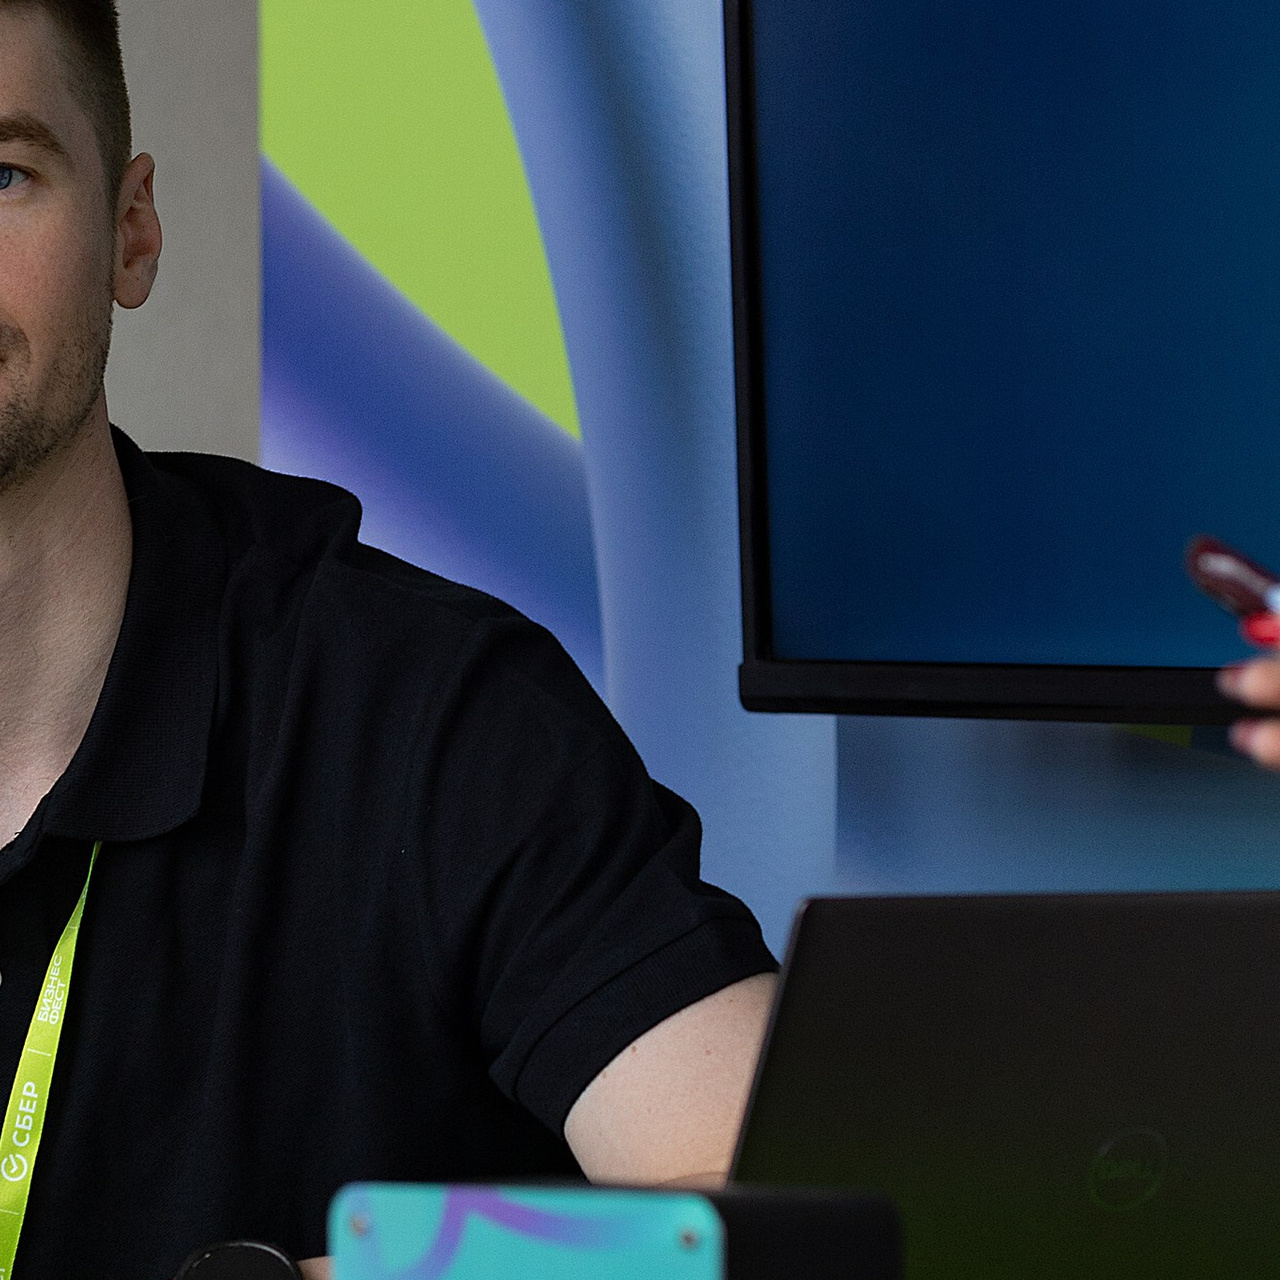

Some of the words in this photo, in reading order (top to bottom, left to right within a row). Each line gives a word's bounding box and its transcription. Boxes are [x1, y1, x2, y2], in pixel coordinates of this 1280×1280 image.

[37, 954, 63, 1022] БИЗНЕС
[49, 979, 66, 1025] ФЕСТ
[12, 1080, 39, 1147] СБЕР
